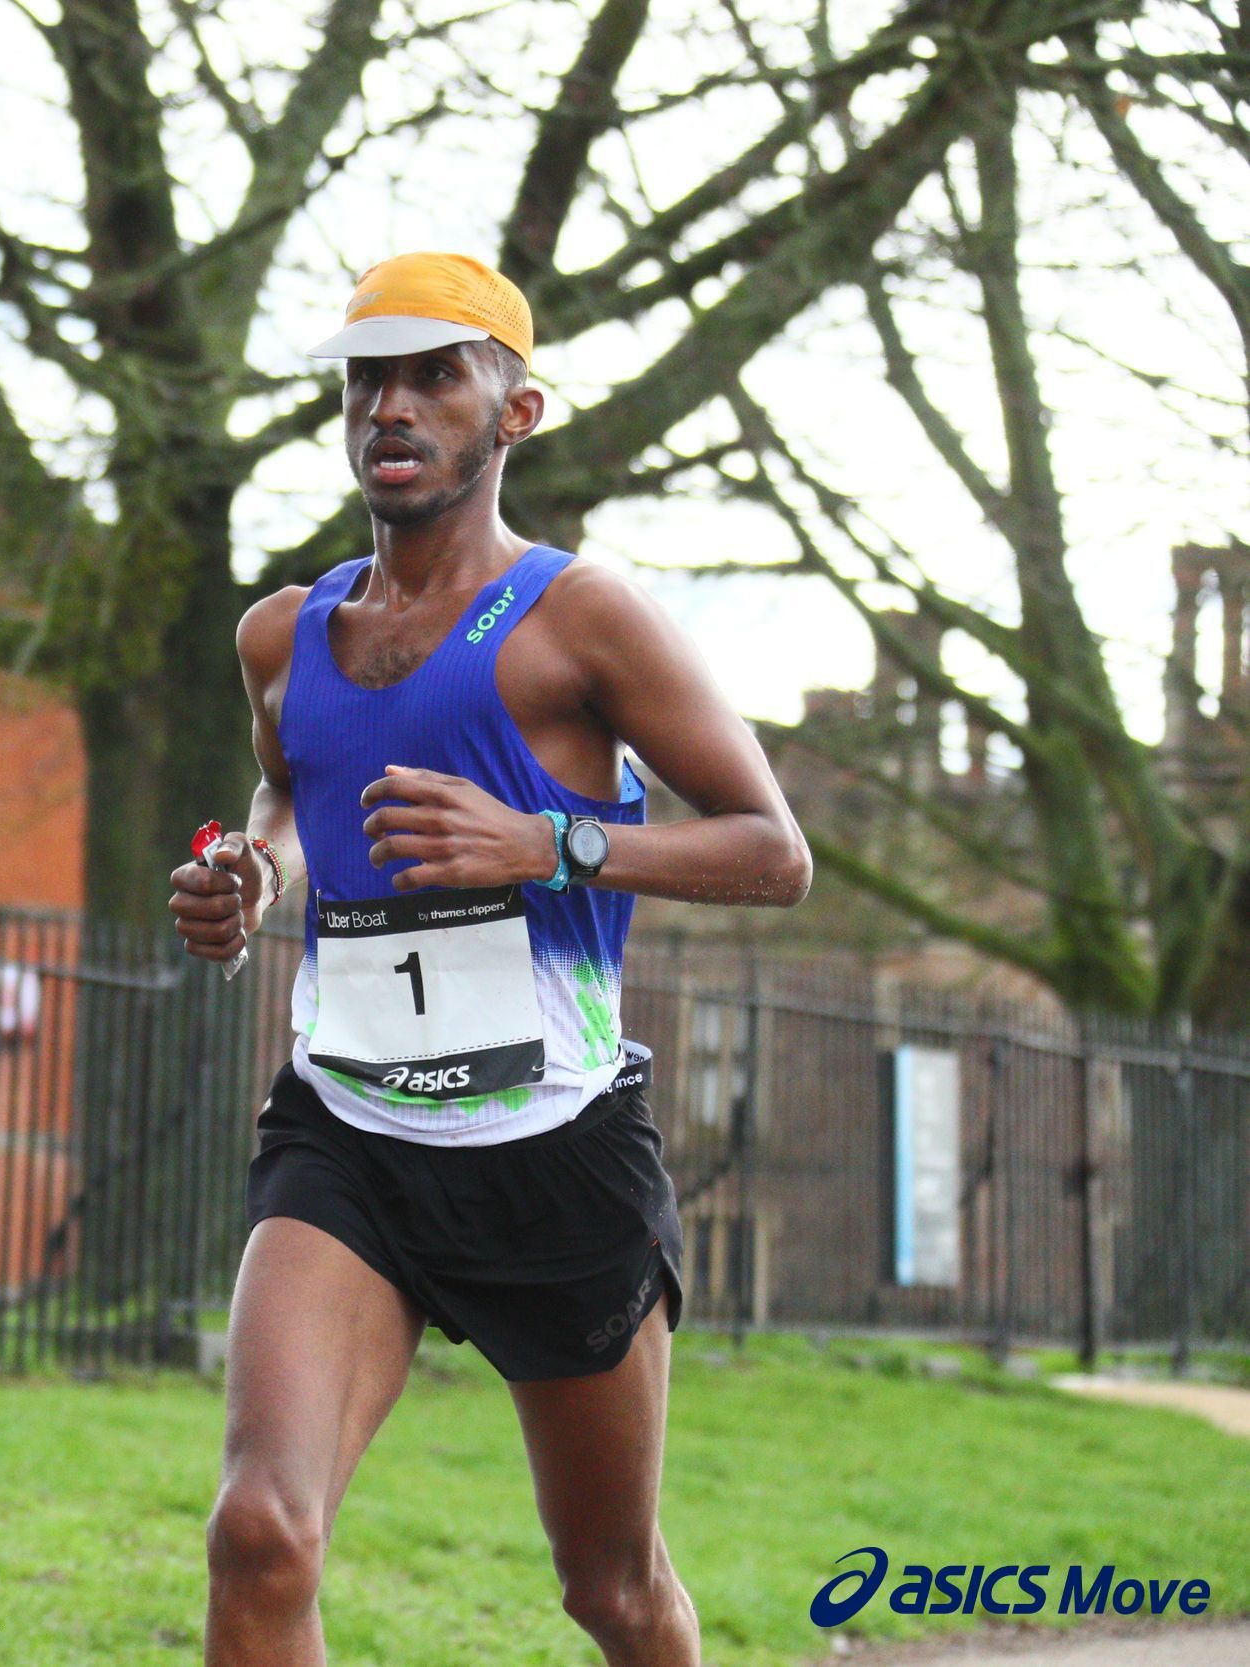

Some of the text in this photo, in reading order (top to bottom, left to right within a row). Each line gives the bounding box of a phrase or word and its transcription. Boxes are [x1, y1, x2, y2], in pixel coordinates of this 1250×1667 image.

[326, 910, 388, 929] Uber Boat
[418, 902, 506, 923] by thames clippers
[393, 951, 425, 1016] 1
